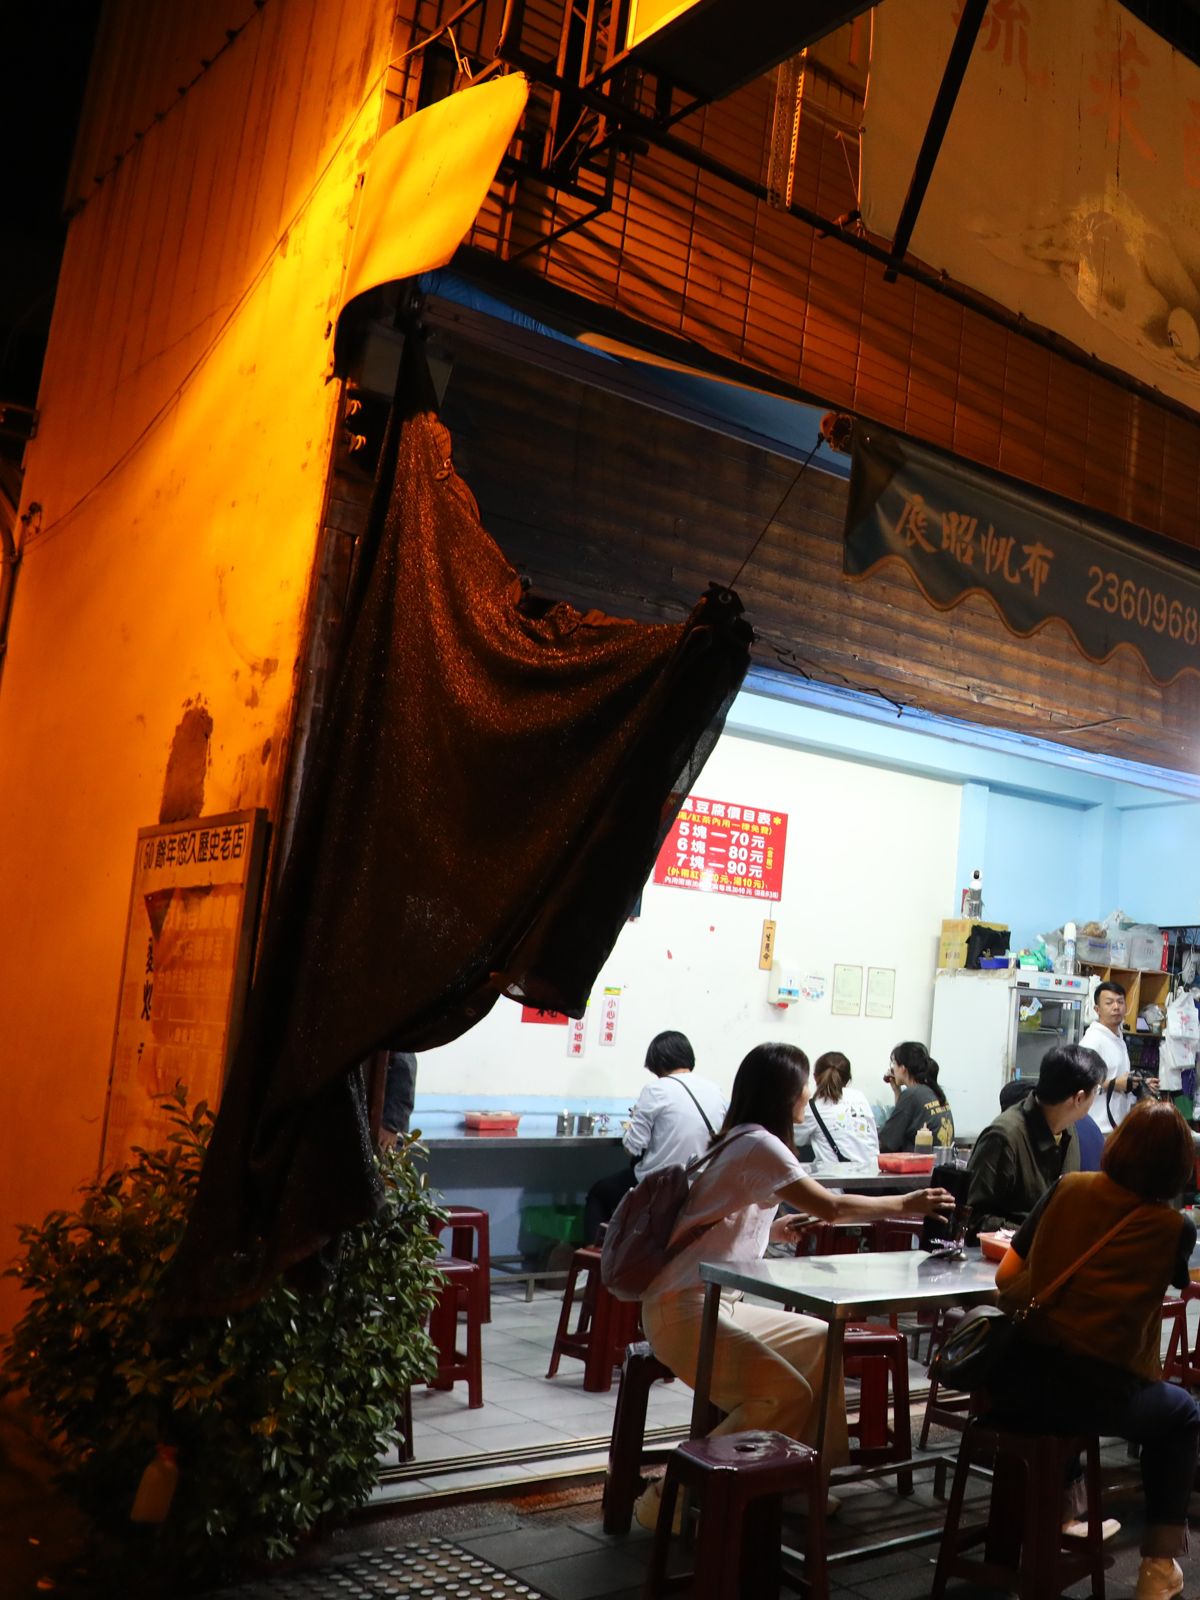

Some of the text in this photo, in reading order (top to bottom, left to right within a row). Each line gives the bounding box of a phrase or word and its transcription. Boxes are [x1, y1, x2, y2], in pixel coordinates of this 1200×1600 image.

[572, 1020, 584, 1054] 心地滑
[604, 1000, 617, 1041] 小心地滑
